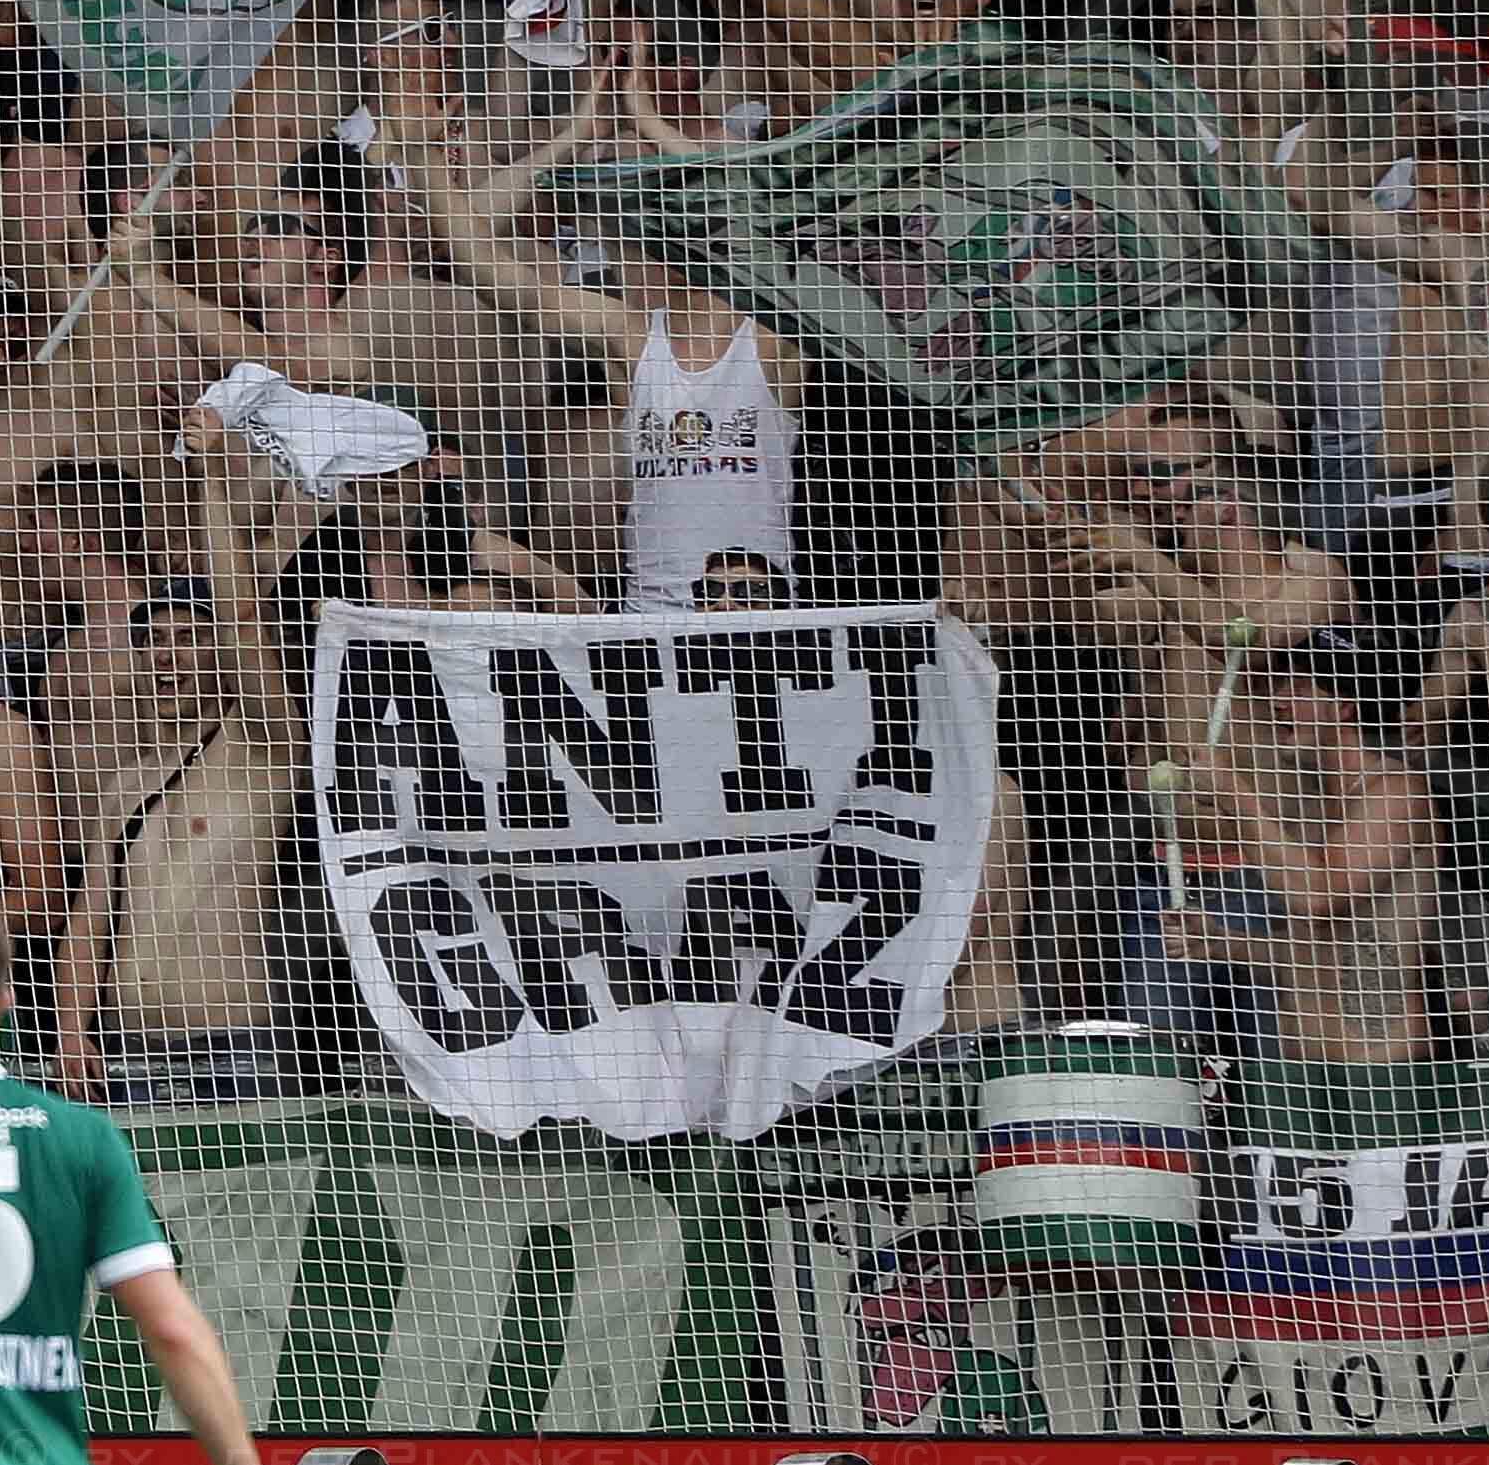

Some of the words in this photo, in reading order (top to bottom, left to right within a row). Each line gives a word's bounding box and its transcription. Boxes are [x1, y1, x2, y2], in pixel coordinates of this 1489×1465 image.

[635, 455, 760, 480] ULTRAS
[323, 620, 939, 834] ANTI
[365, 844, 925, 1055] GRAZ
